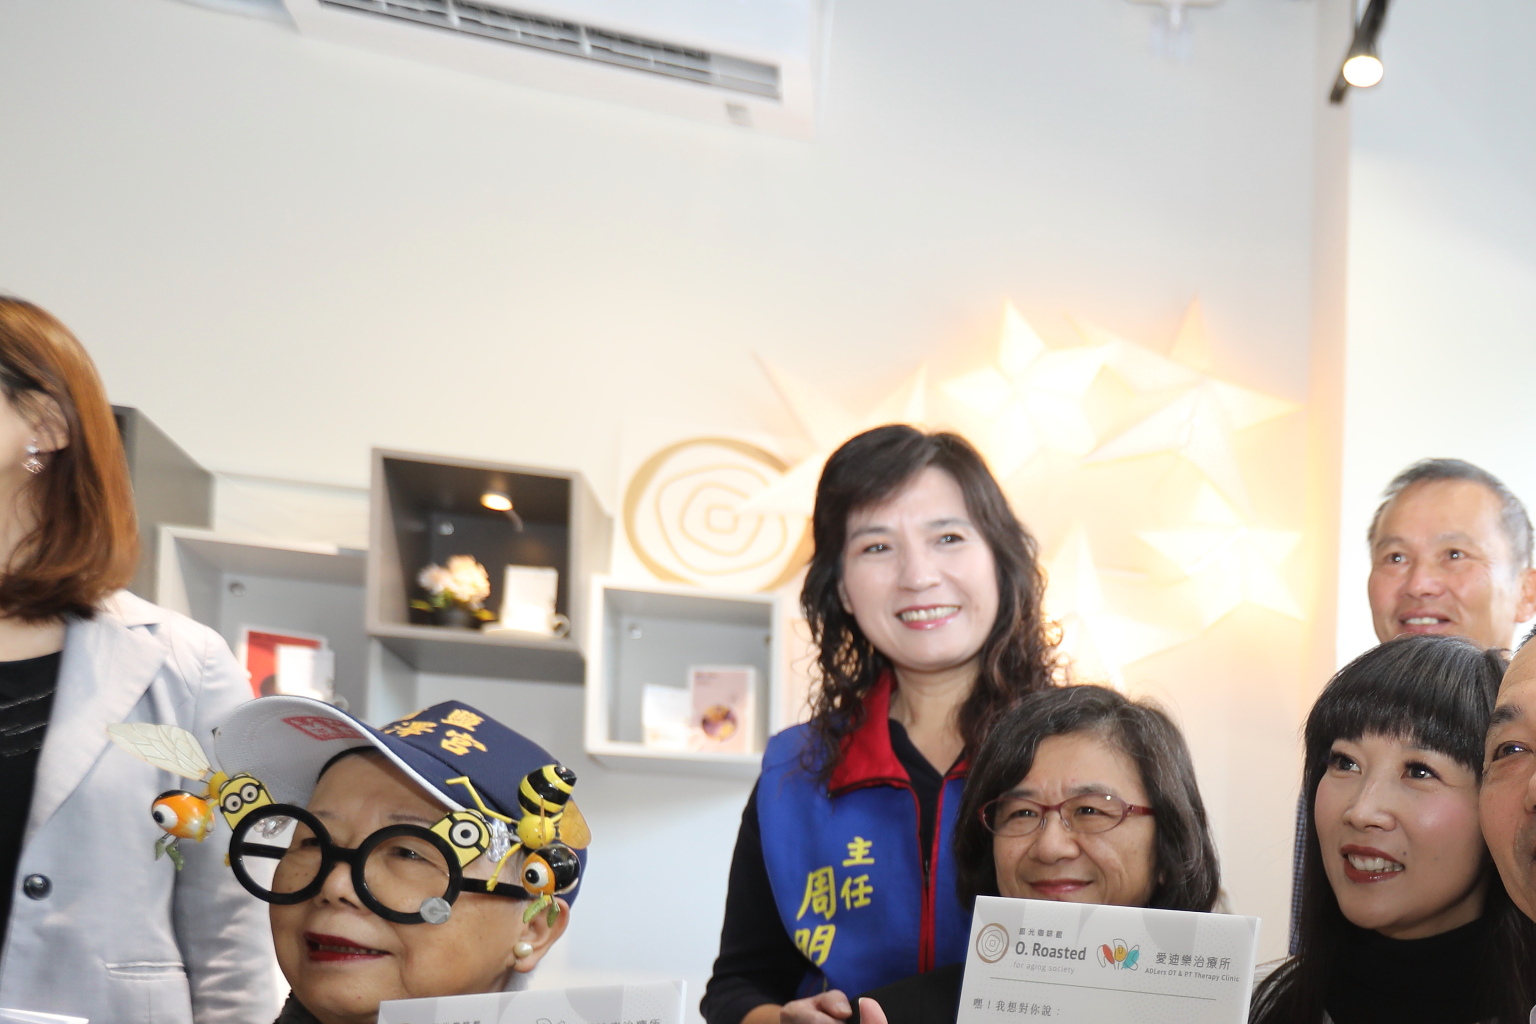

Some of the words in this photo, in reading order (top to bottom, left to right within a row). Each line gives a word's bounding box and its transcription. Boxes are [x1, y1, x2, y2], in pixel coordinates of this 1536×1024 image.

[840, 836, 875, 910] 主任
[1015, 941, 1029, 956] O.
[1032, 939, 1087, 961] Roasted
[1025, 961, 1046, 973] aging
[1048, 964, 1075, 975] society
[1155, 951, 1231, 971] 愛迪樂治療所
[1193, 971, 1220, 982] Therapy
[1221, 973, 1240, 983] Clinic
